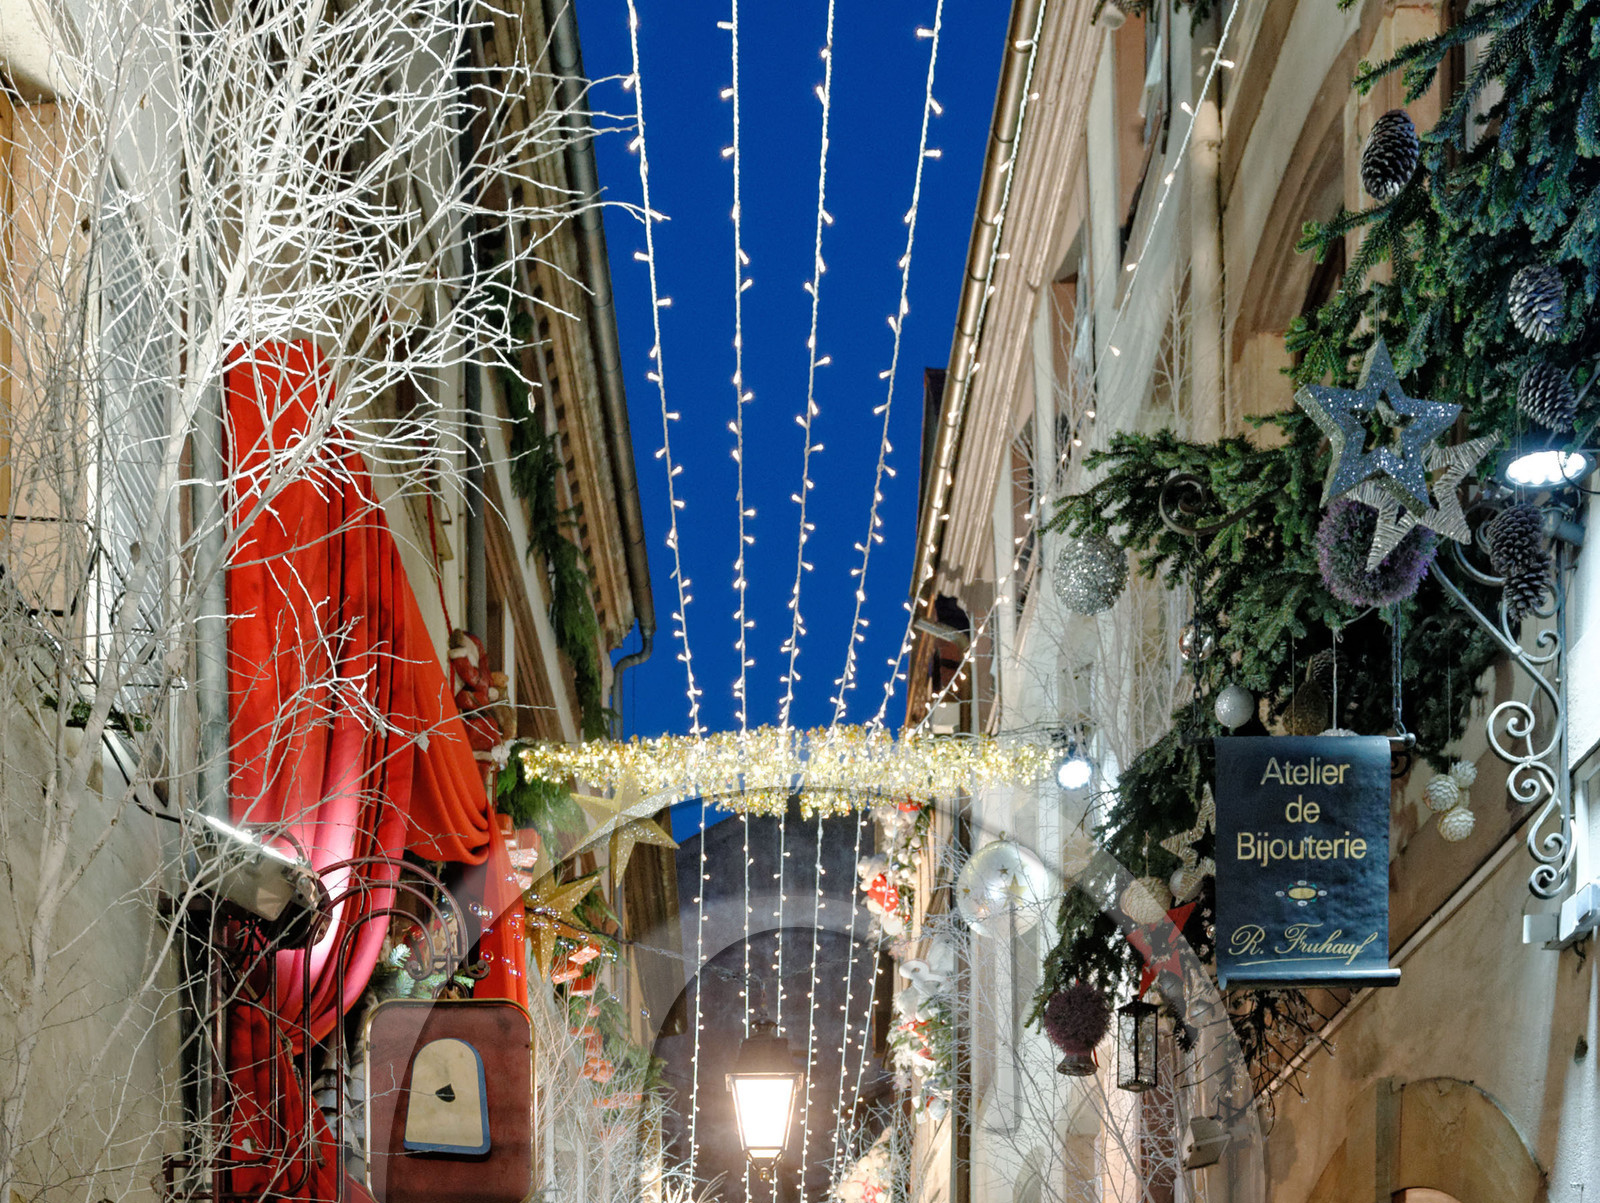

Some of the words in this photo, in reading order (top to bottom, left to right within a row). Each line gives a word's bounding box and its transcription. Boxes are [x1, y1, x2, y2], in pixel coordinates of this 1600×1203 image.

[1260, 757, 1350, 785] Atelier
[1285, 795, 1320, 823] de
[1237, 831, 1367, 867] Bijouterie
[1228, 924, 1264, 956] R.
